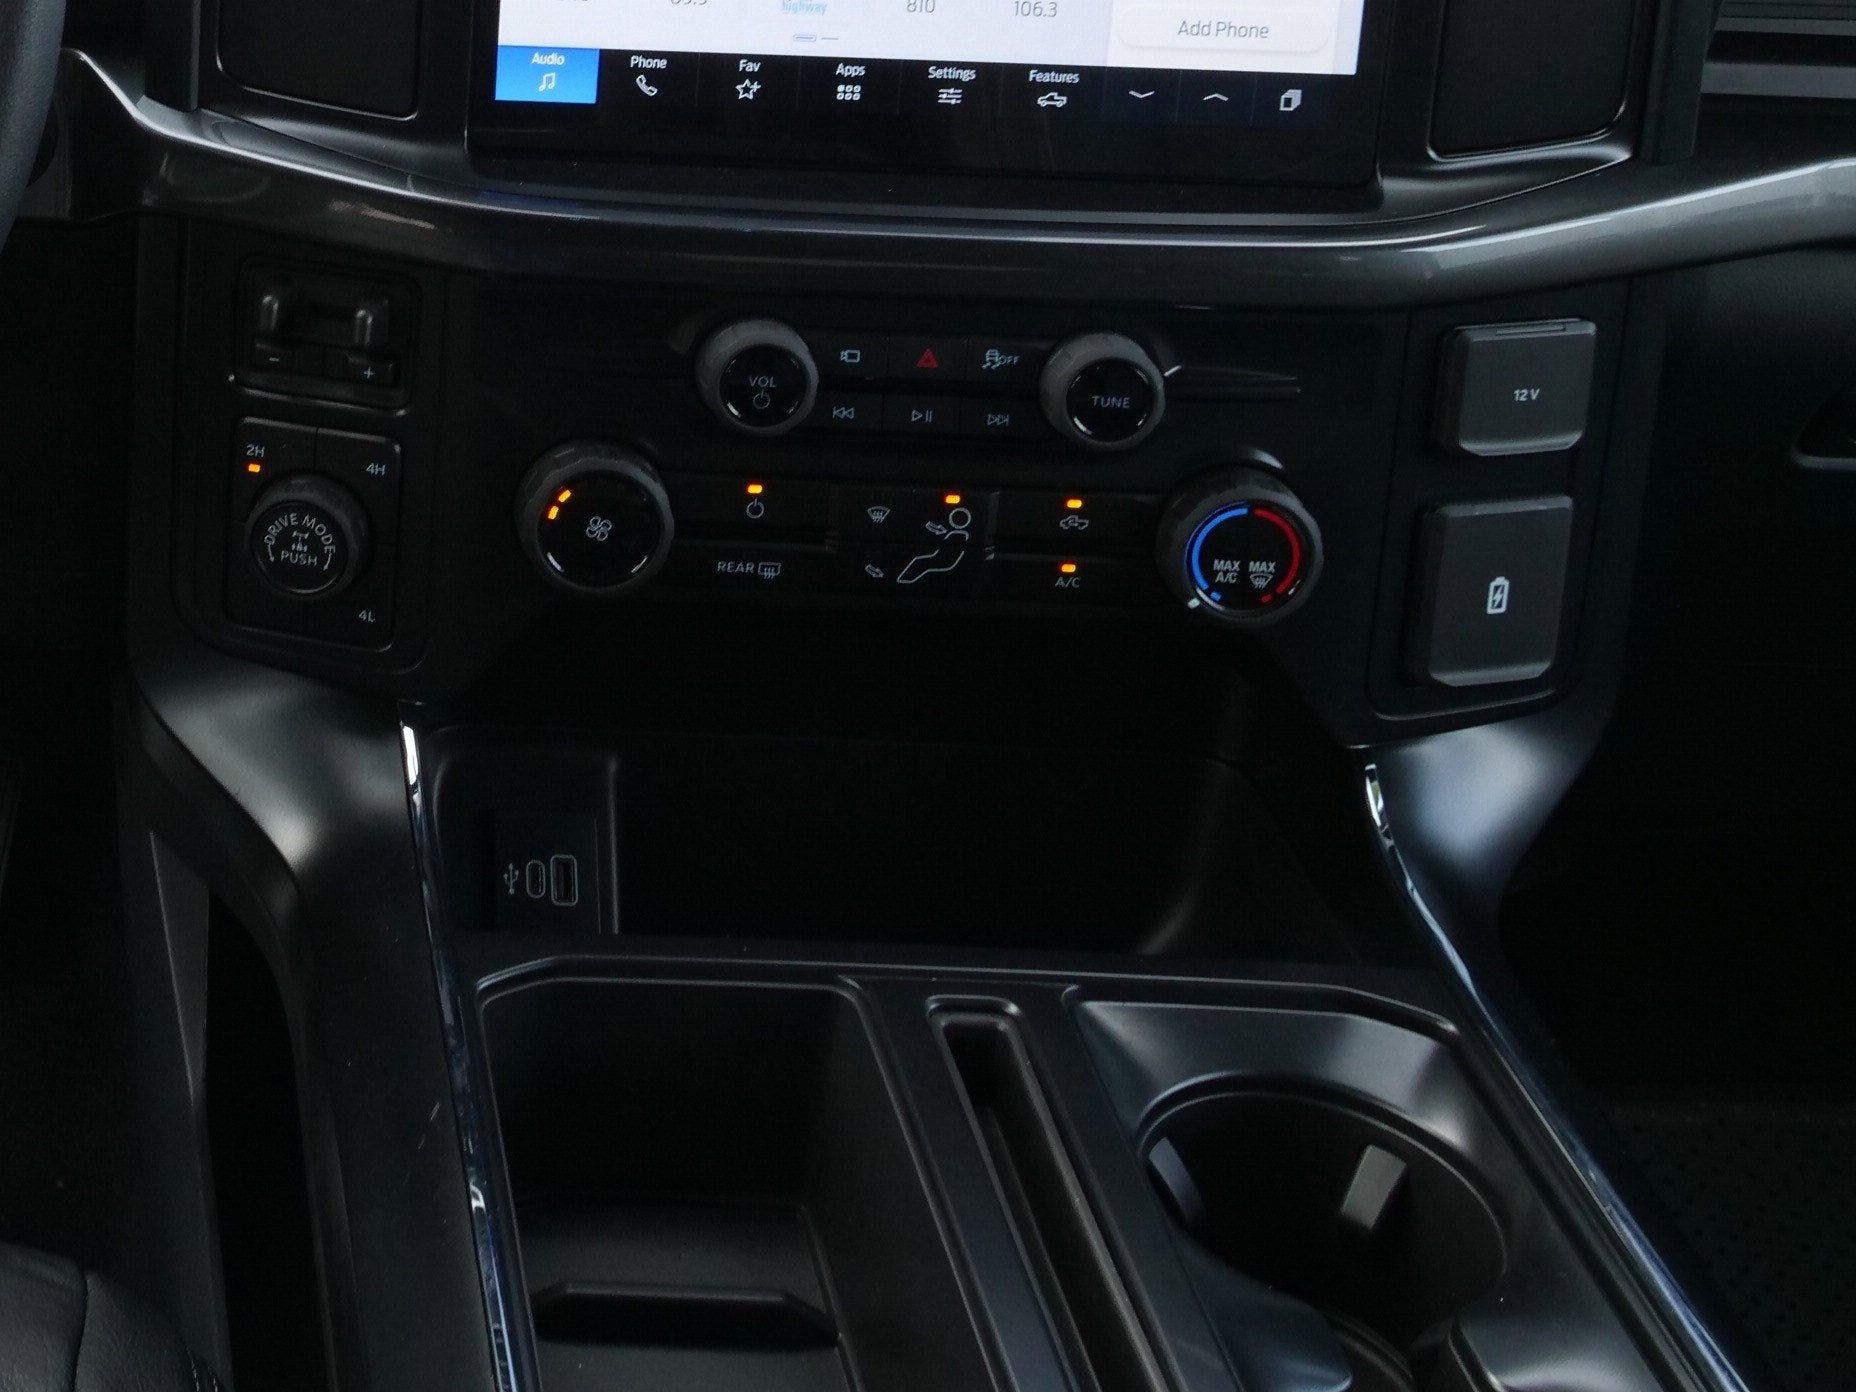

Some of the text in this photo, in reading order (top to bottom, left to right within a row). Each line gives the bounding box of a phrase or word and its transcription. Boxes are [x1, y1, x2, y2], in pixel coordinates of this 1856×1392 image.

[1014, 0, 1058, 18] 106.3
[1177, 20, 1270, 40] Add Phone
[531, 52, 565, 66] Audio
[630, 55, 667, 70] Phone
[738, 59, 761, 74] Fav
[836, 62, 866, 79] Apps
[927, 65, 977, 82] Settings
[1028, 69, 1080, 84] Features
[1000, 354, 1021, 367] OFF
[748, 375, 777, 389] VOL
[1091, 395, 1131, 409] TUNE
[247, 444, 265, 458] 2H
[366, 463, 386, 476] 4H
[264, 513, 336, 554] DRIVE MODE
[280, 550, 318, 566] PUSH
[717, 562, 755, 575] REAR
[1213, 560, 1241, 573] MAX
[1248, 561, 1276, 574] MAX
[1055, 576, 1081, 589] A/C
[1215, 571, 1238, 584] A/C
[358, 610, 375, 623] 4L
